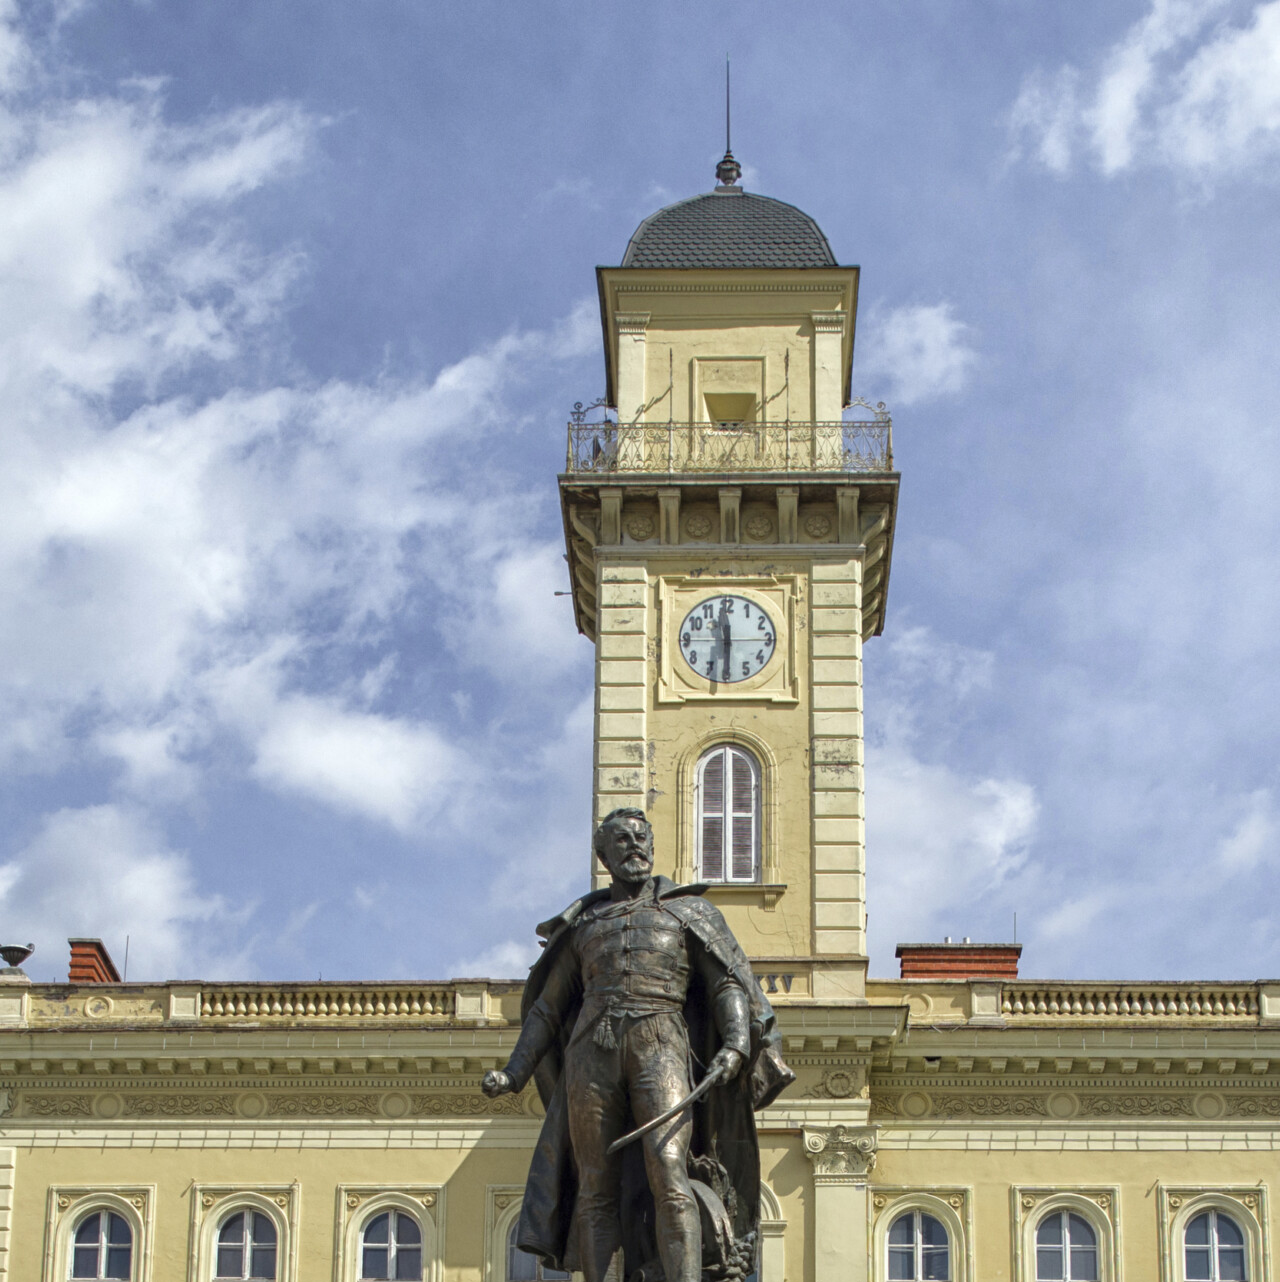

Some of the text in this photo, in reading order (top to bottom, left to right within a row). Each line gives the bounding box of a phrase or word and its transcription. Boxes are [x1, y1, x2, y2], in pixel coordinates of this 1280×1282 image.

[702, 604, 714, 619] 11
[743, 603, 750, 619] 1
[688, 616, 703, 631] 10
[757, 615, 766, 631] 2
[682, 632, 691, 648] 9
[764, 631, 773, 647] 3
[689, 649, 698, 665] 8
[755, 649, 764, 665] 4
[706, 660, 714, 676] 7
[742, 661, 750, 676] 5
